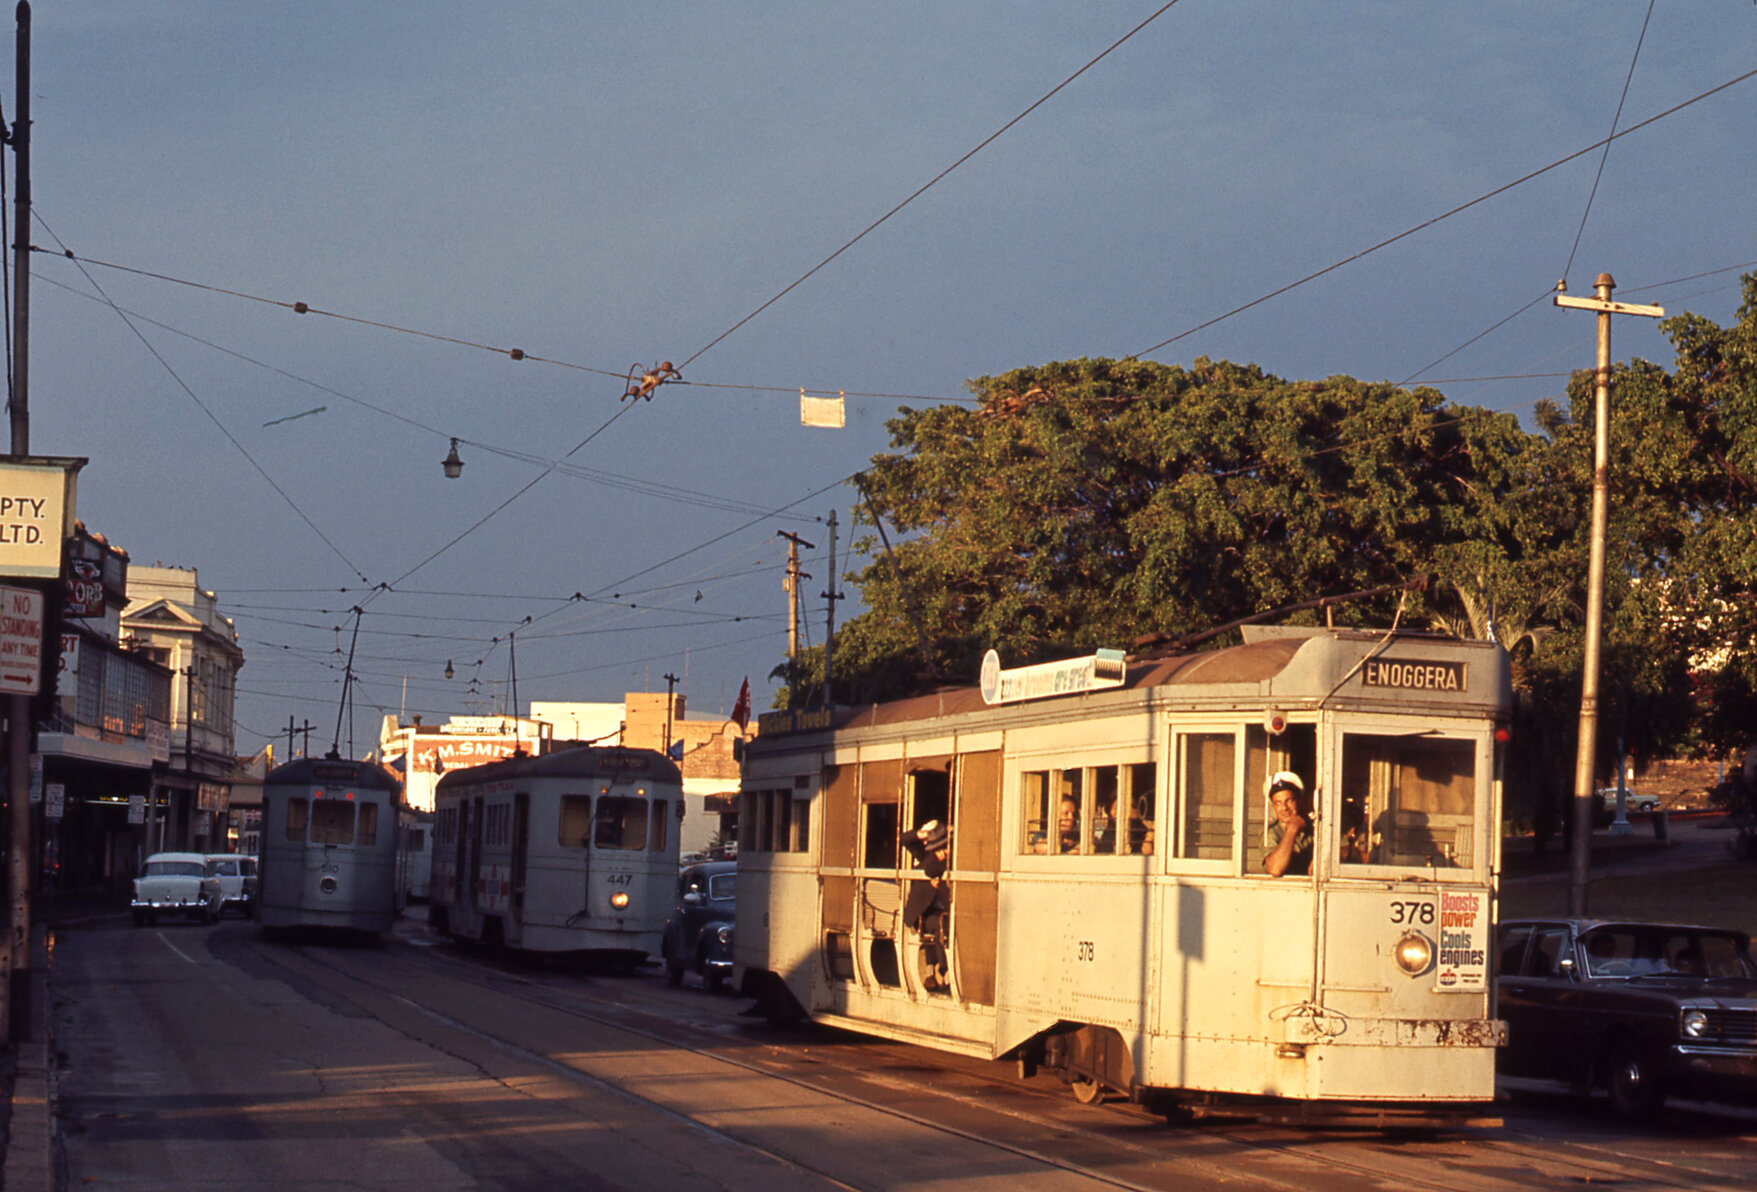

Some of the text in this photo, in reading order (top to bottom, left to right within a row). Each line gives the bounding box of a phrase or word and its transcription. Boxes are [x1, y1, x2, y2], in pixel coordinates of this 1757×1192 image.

[0, 497, 46, 518] PTY.
[0, 523, 44, 544] LTD.
[13, 594, 31, 615] NO
[1, 615, 40, 639] STANDING
[2, 640, 38, 658] ANY TIME
[1366, 661, 1458, 691] ENOGGERA
[607, 872, 632, 886] 447
[1441, 892, 1479, 911] Boosts
[1390, 901, 1435, 924] 378
[1441, 911, 1477, 931] power
[1441, 930, 1472, 949] Cools
[1078, 941, 1094, 962] 378
[1440, 949, 1484, 968] engines
